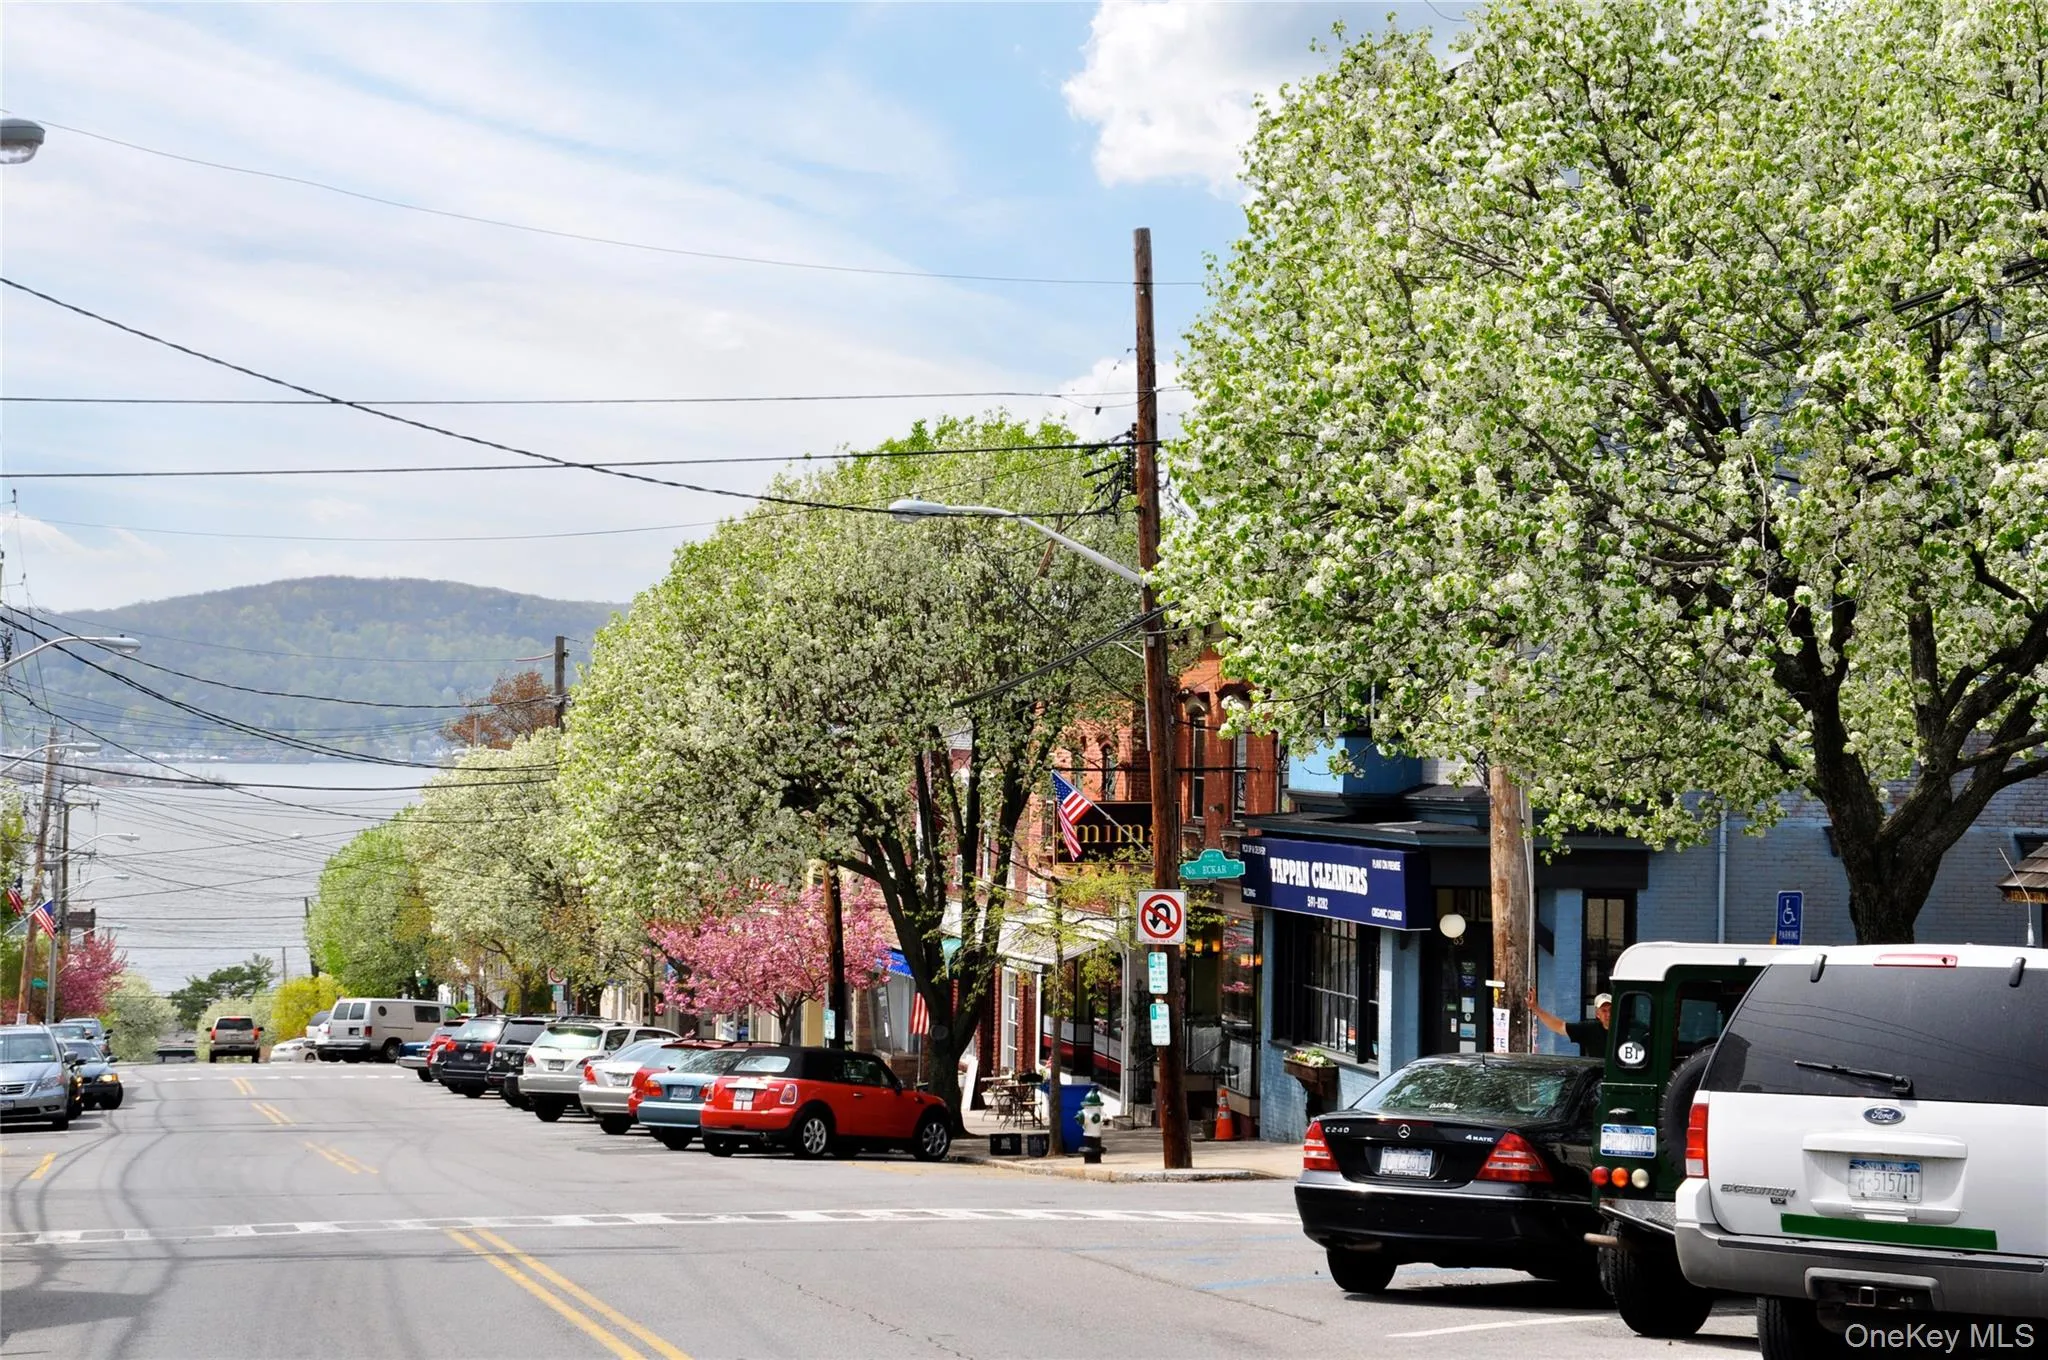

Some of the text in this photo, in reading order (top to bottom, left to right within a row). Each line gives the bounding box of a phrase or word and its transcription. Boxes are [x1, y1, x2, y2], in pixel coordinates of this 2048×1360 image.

[1269, 857, 1368, 896] TAPPAN CLEANERS
[1779, 930, 1799, 940] PARKING
[1871, 1108, 1896, 1120] Ford
[1720, 1184, 1796, 1198] EXPEDITION
